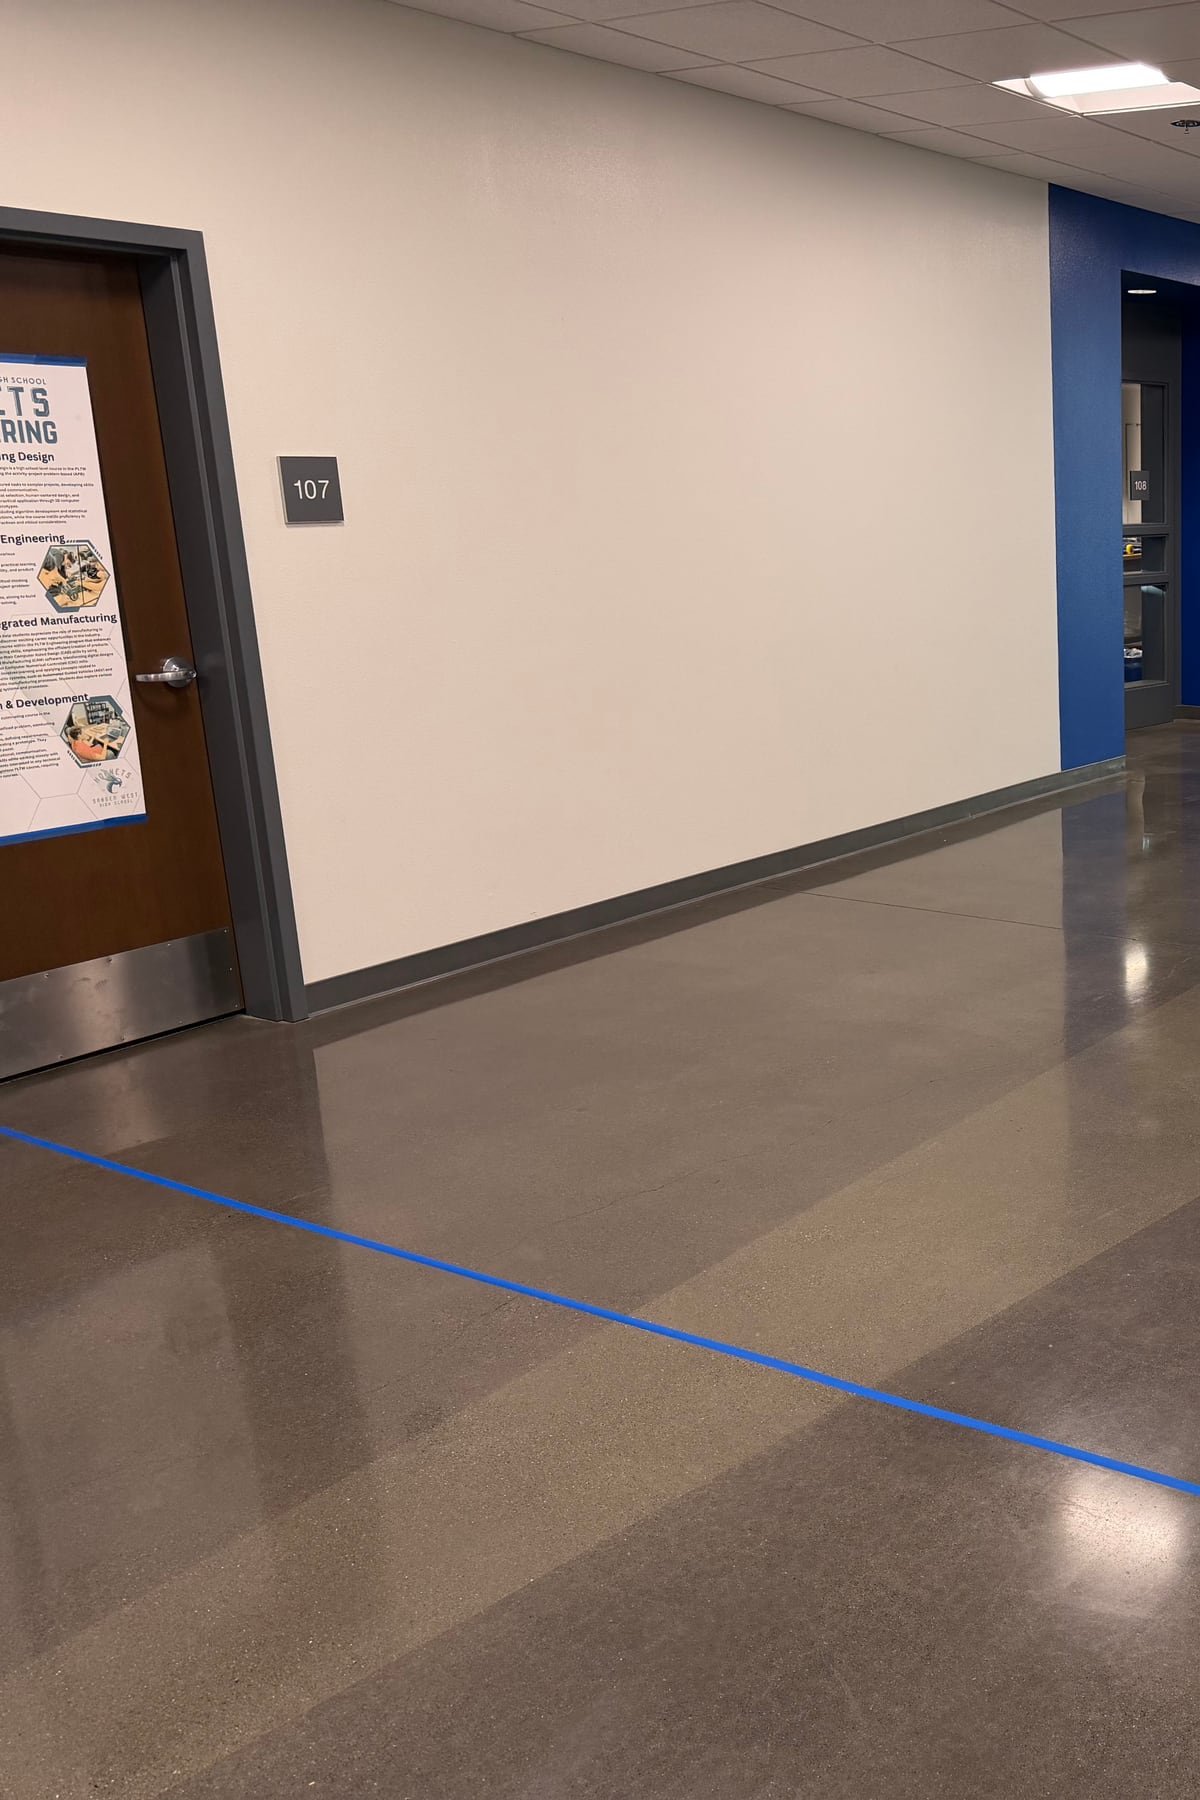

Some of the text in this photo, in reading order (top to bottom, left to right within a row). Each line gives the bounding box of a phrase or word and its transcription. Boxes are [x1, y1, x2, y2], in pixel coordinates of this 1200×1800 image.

[11, 377, 46, 385] SCHOOL
[0, 386, 49, 417] TS
[18, 452, 54, 463] Design
[294, 480, 329, 499] 107
[1135, 481, 1146, 490] 108
[1, 534, 65, 545] Engineering
[0, 614, 117, 630] grated Manufacturing
[6, 700, 13, 709] &
[16, 693, 89, 708] Development
